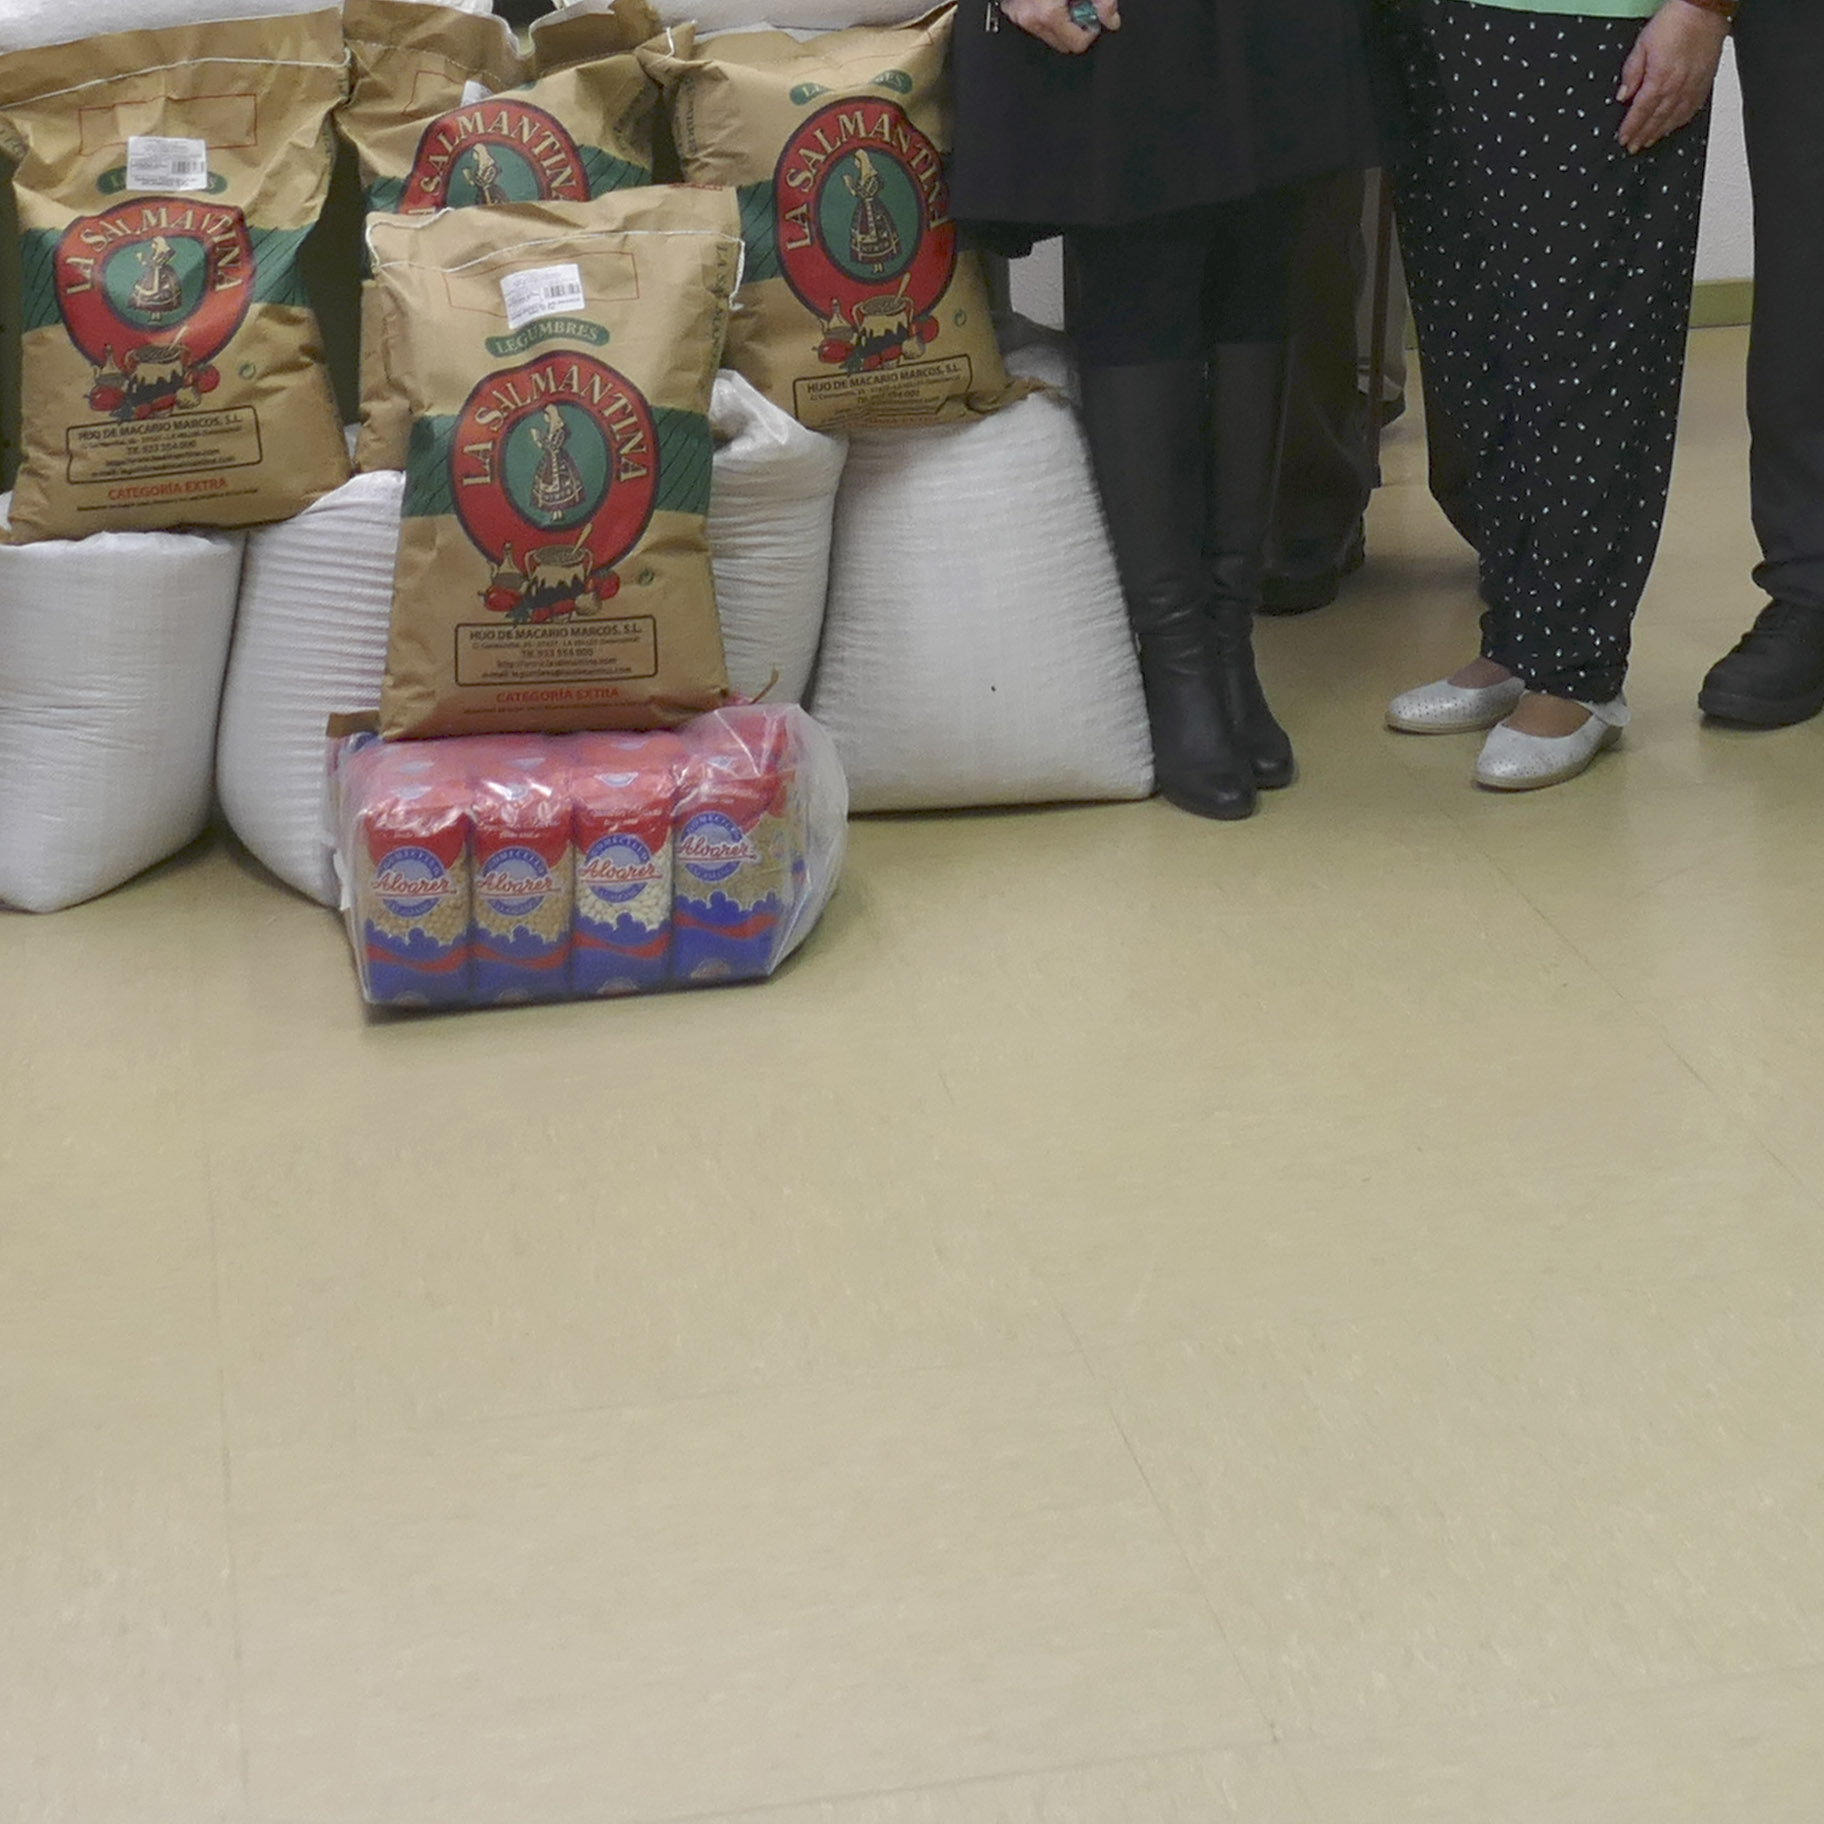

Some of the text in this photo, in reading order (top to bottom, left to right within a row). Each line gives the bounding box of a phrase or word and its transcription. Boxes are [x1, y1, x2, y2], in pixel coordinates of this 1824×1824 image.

[420, 110, 576, 201] SALMANTIN
[786, 110, 948, 229] SALMANTINA
[785, 204, 812, 250] LA
[66, 257, 94, 294] LA
[496, 322, 598, 354] LEGUMBRES
[463, 365, 647, 486] LA SALMANTINA
[185, 478, 228, 493] EXTRA
